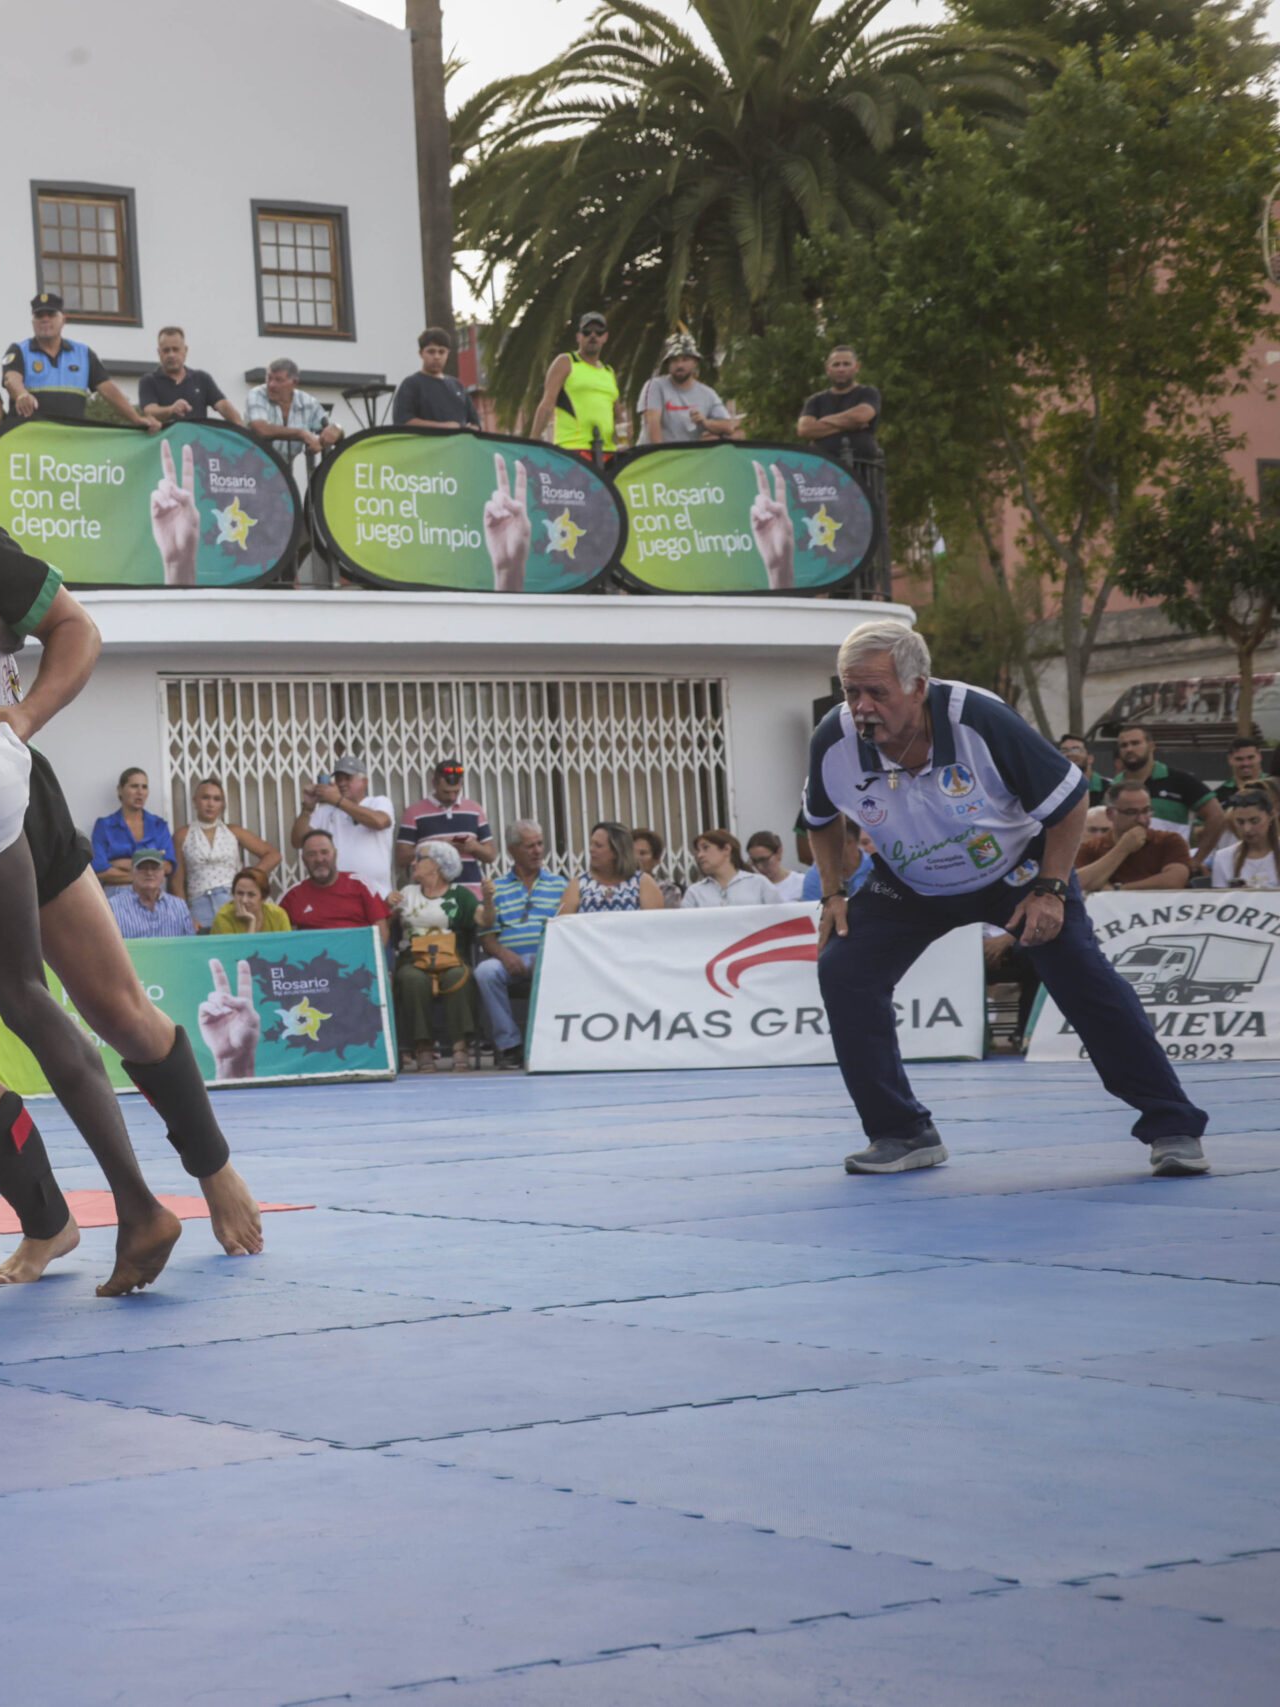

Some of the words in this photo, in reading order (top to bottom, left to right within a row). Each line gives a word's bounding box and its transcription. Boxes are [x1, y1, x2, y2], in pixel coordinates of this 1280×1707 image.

[10, 453, 32, 481] El
[39, 454, 125, 485] Rosario
[209, 458, 220, 471] El
[210, 473, 256, 488] Rosario
[355, 463, 374, 489] El
[380, 465, 457, 495] Rosario
[539, 472, 552, 485] El
[10, 489, 53, 509] con
[60, 482, 81, 511] el
[354, 496, 394, 516] con
[399, 492, 419, 519] el
[541, 485, 585, 501] Rosario
[628, 483, 649, 508] El
[653, 482, 725, 507] Rosario
[12, 508, 101, 543] deporte
[633, 514, 671, 533] con
[674, 505, 693, 530] el
[355, 516, 413, 549] juego
[418, 519, 481, 552] limpio
[637, 535, 691, 562] juego
[693, 529, 752, 557] limpio
[271, 967, 284, 979] El
[272, 977, 329, 990] Rosario
[750, 997, 963, 1036] GRIA
